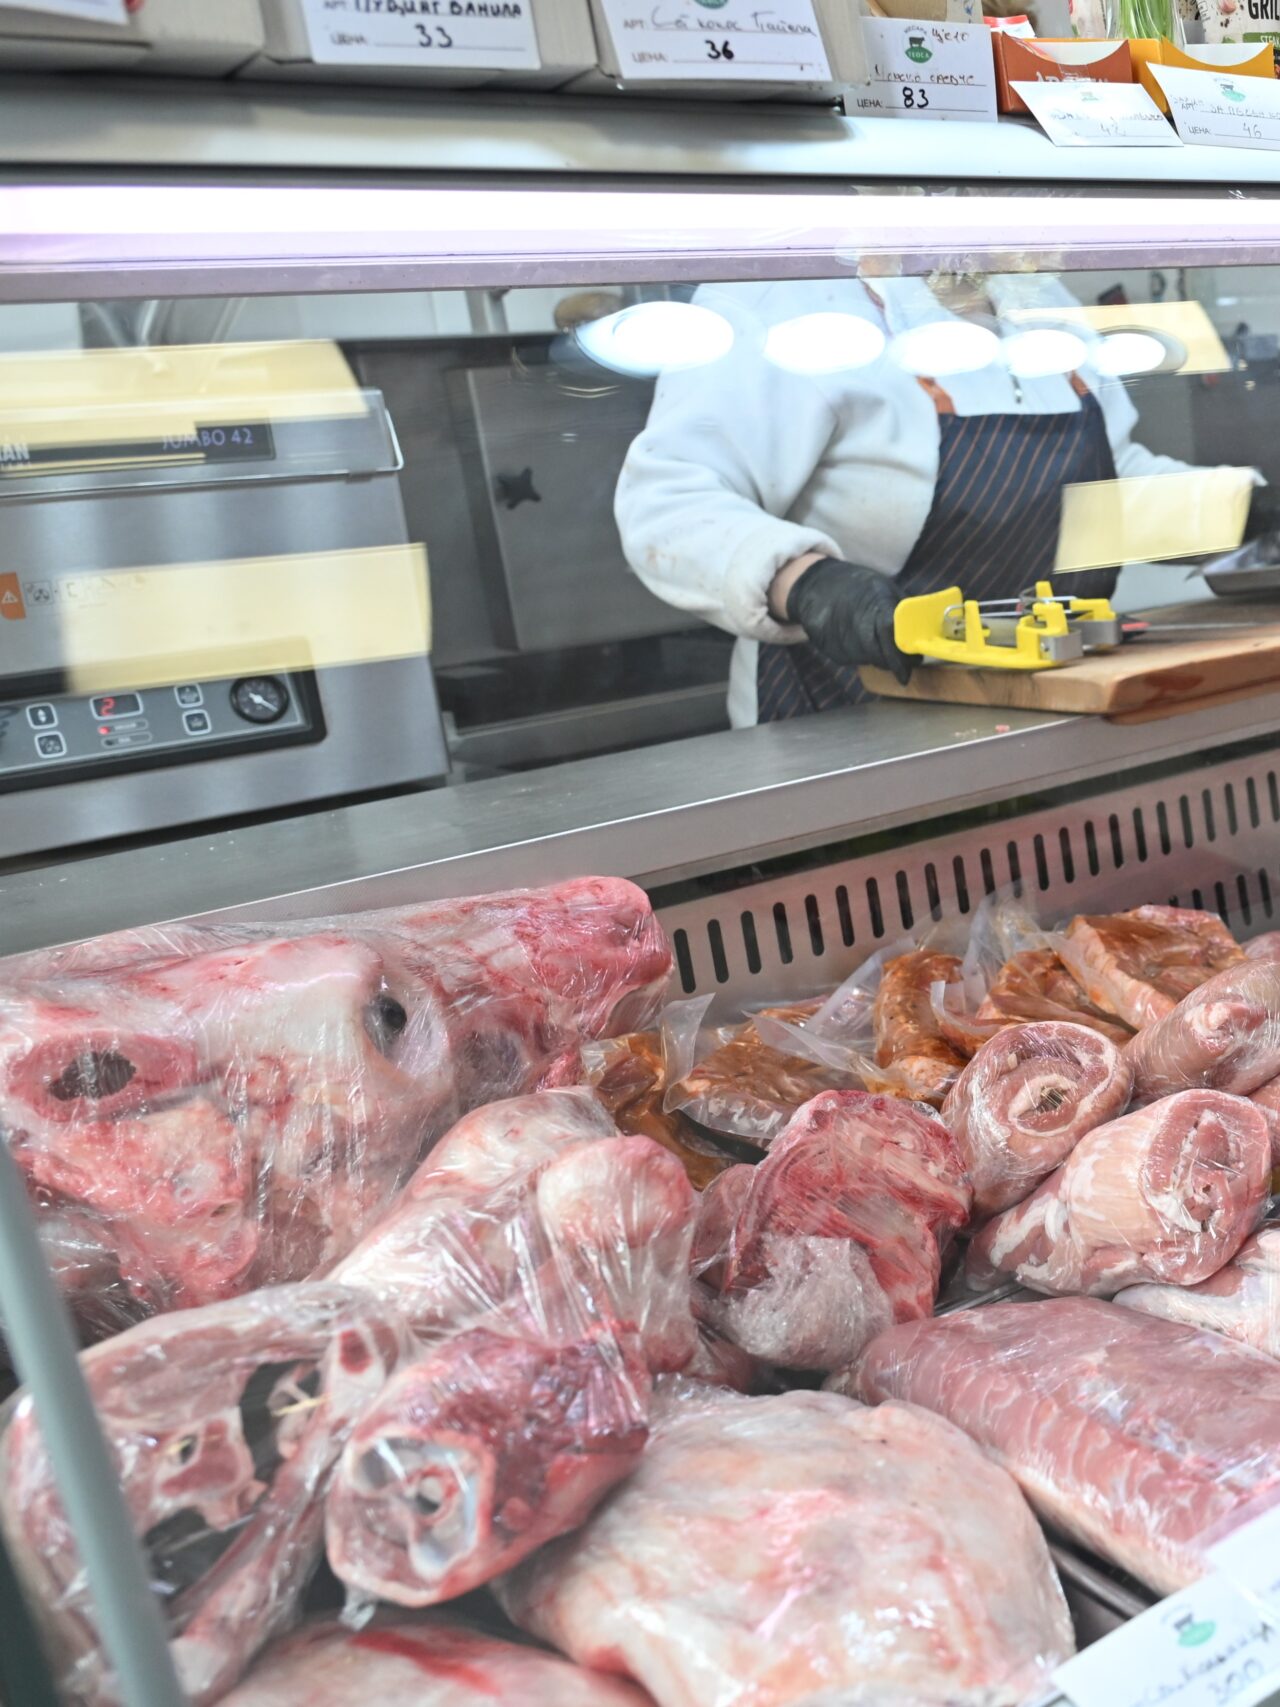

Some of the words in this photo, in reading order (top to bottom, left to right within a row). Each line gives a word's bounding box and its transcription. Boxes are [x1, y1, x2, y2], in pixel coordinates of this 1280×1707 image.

[415, 23, 453, 49] 33
[704, 39, 735, 61] 36
[902, 86, 929, 109] 83
[163, 428, 225, 450] JUMBO
[231, 427, 253, 445] 42
